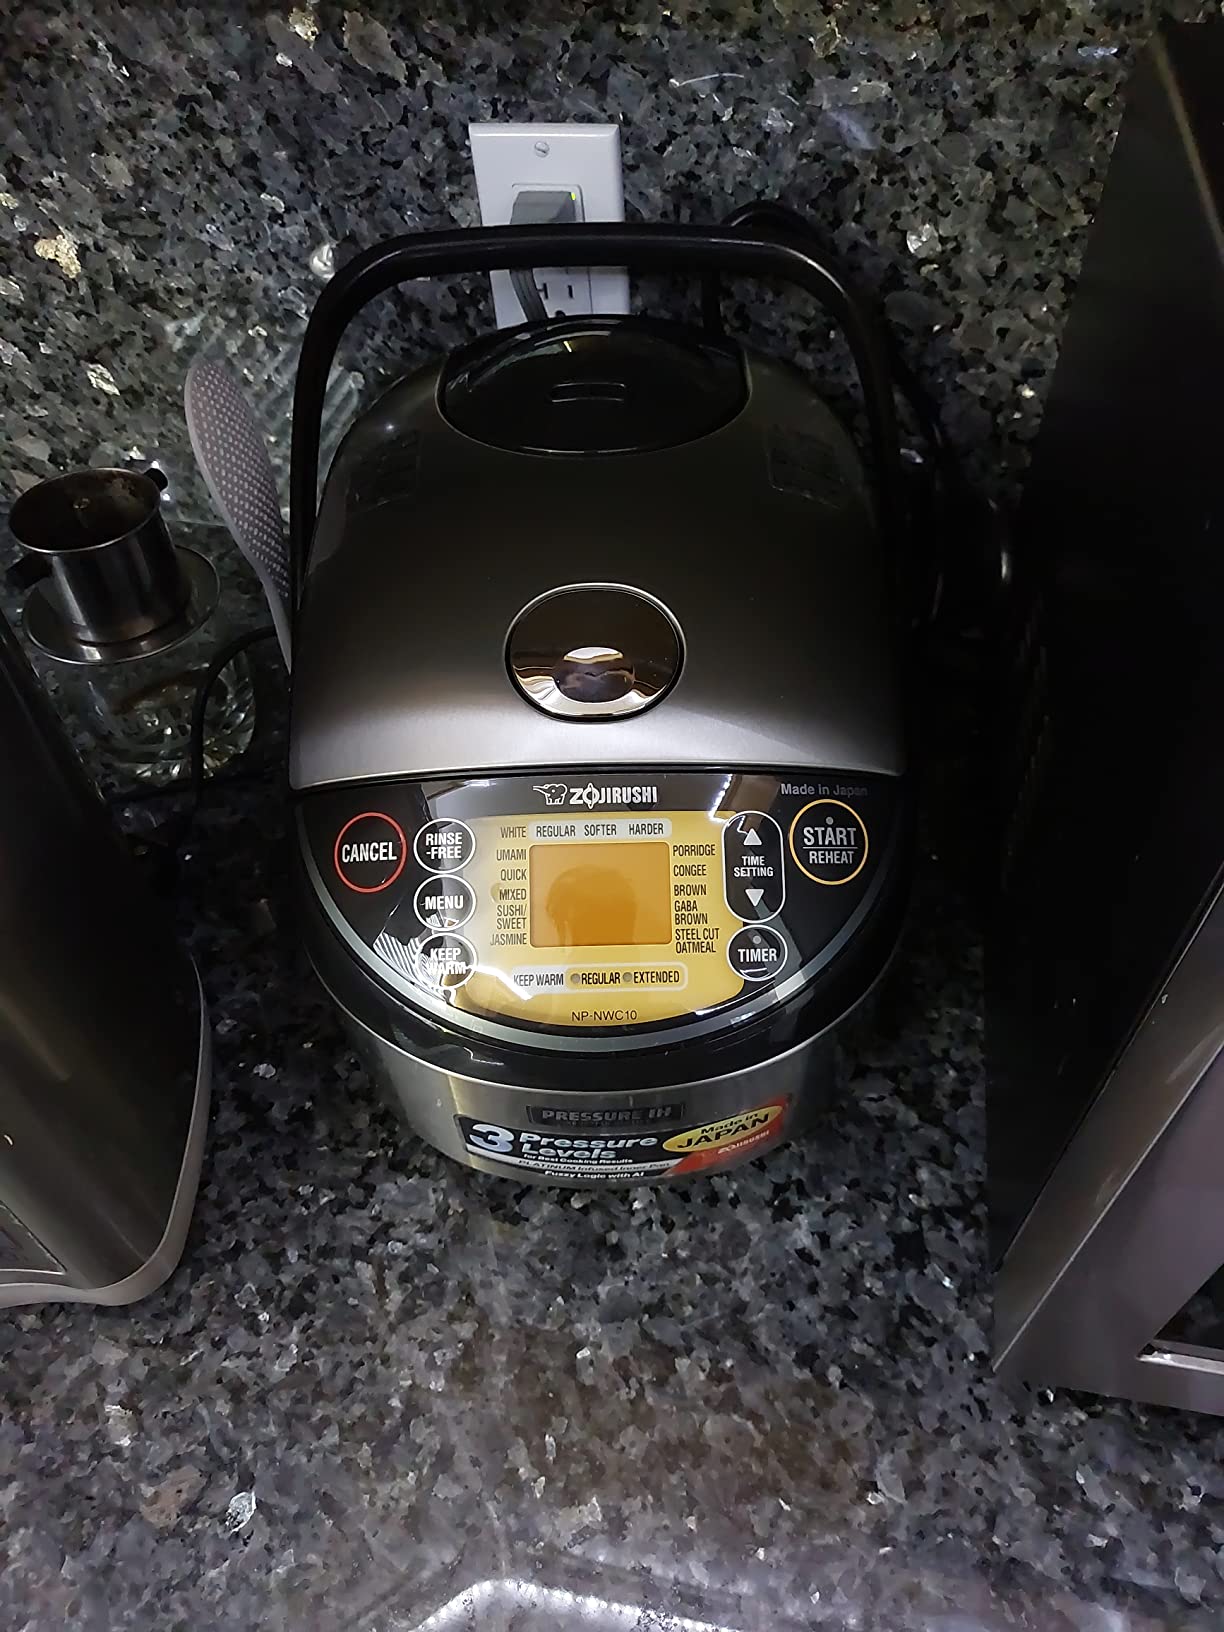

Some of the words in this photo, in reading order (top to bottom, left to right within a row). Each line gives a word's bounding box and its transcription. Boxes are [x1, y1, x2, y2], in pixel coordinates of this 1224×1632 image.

[569, 783, 658, 809] ZOJIRUSHI
[781, 783, 815, 795] Made
[818, 784, 830, 795] in
[833, 785, 868, 798] Japan
[500, 827, 527, 838] WHITE
[536, 824, 576, 837] REGULAR
[584, 823, 617, 836] SOFTER
[628, 823, 664, 836] HARDER
[803, 827, 857, 846] START
[425, 833, 463, 845] RINSE
[341, 842, 397, 863] CANCEL
[425, 846, 462, 859] -FREE
[496, 849, 527, 861] UMAMI
[673, 844, 716, 857] PORRIDGE
[741, 856, 765, 866] TIME
[809, 851, 854, 864] REHEAT
[500, 869, 527, 881] QUICK
[673, 865, 707, 877] CONGEE
[733, 866, 774, 878] SETTING
[499, 889, 527, 901] MIXED
[674, 884, 707, 896] BROWN
[424, 896, 464, 910] MENU
[674, 900, 698, 912] GABA
[496, 904, 527, 917] SUSHI/
[496, 917, 527, 930] SWEET
[675, 913, 708, 925] BROWN
[490, 933, 527, 946] JASMINE
[675, 928, 701, 941] STEEL
[702, 928, 720, 940] CUT
[676, 941, 716, 954] OATMEAL
[430, 948, 461, 961] KEEP
[738, 948, 778, 963] TIMER
[427, 961, 466, 975] WARM
[514, 974, 535, 987] KEEP
[536, 973, 564, 986] WARM
[581, 972, 621, 985] REGULAR
[633, 970, 680, 984] EXTENDED
[571, 1010, 638, 1021] NP-NWC10
[542, 1110, 642, 1121] PRESSURE
[648, 1107, 672, 1118] IH
[700, 1118, 743, 1134] Made
[745, 1112, 758, 1121] in
[677, 1113, 769, 1149] JAPAN
[469, 1123, 515, 1153] 3
[519, 1132, 658, 1149] Pressure
[521, 1143, 617, 1159] Levels
[518, 1160, 576, 1171] PLATINUM
[539, 1155, 559, 1163] Best
